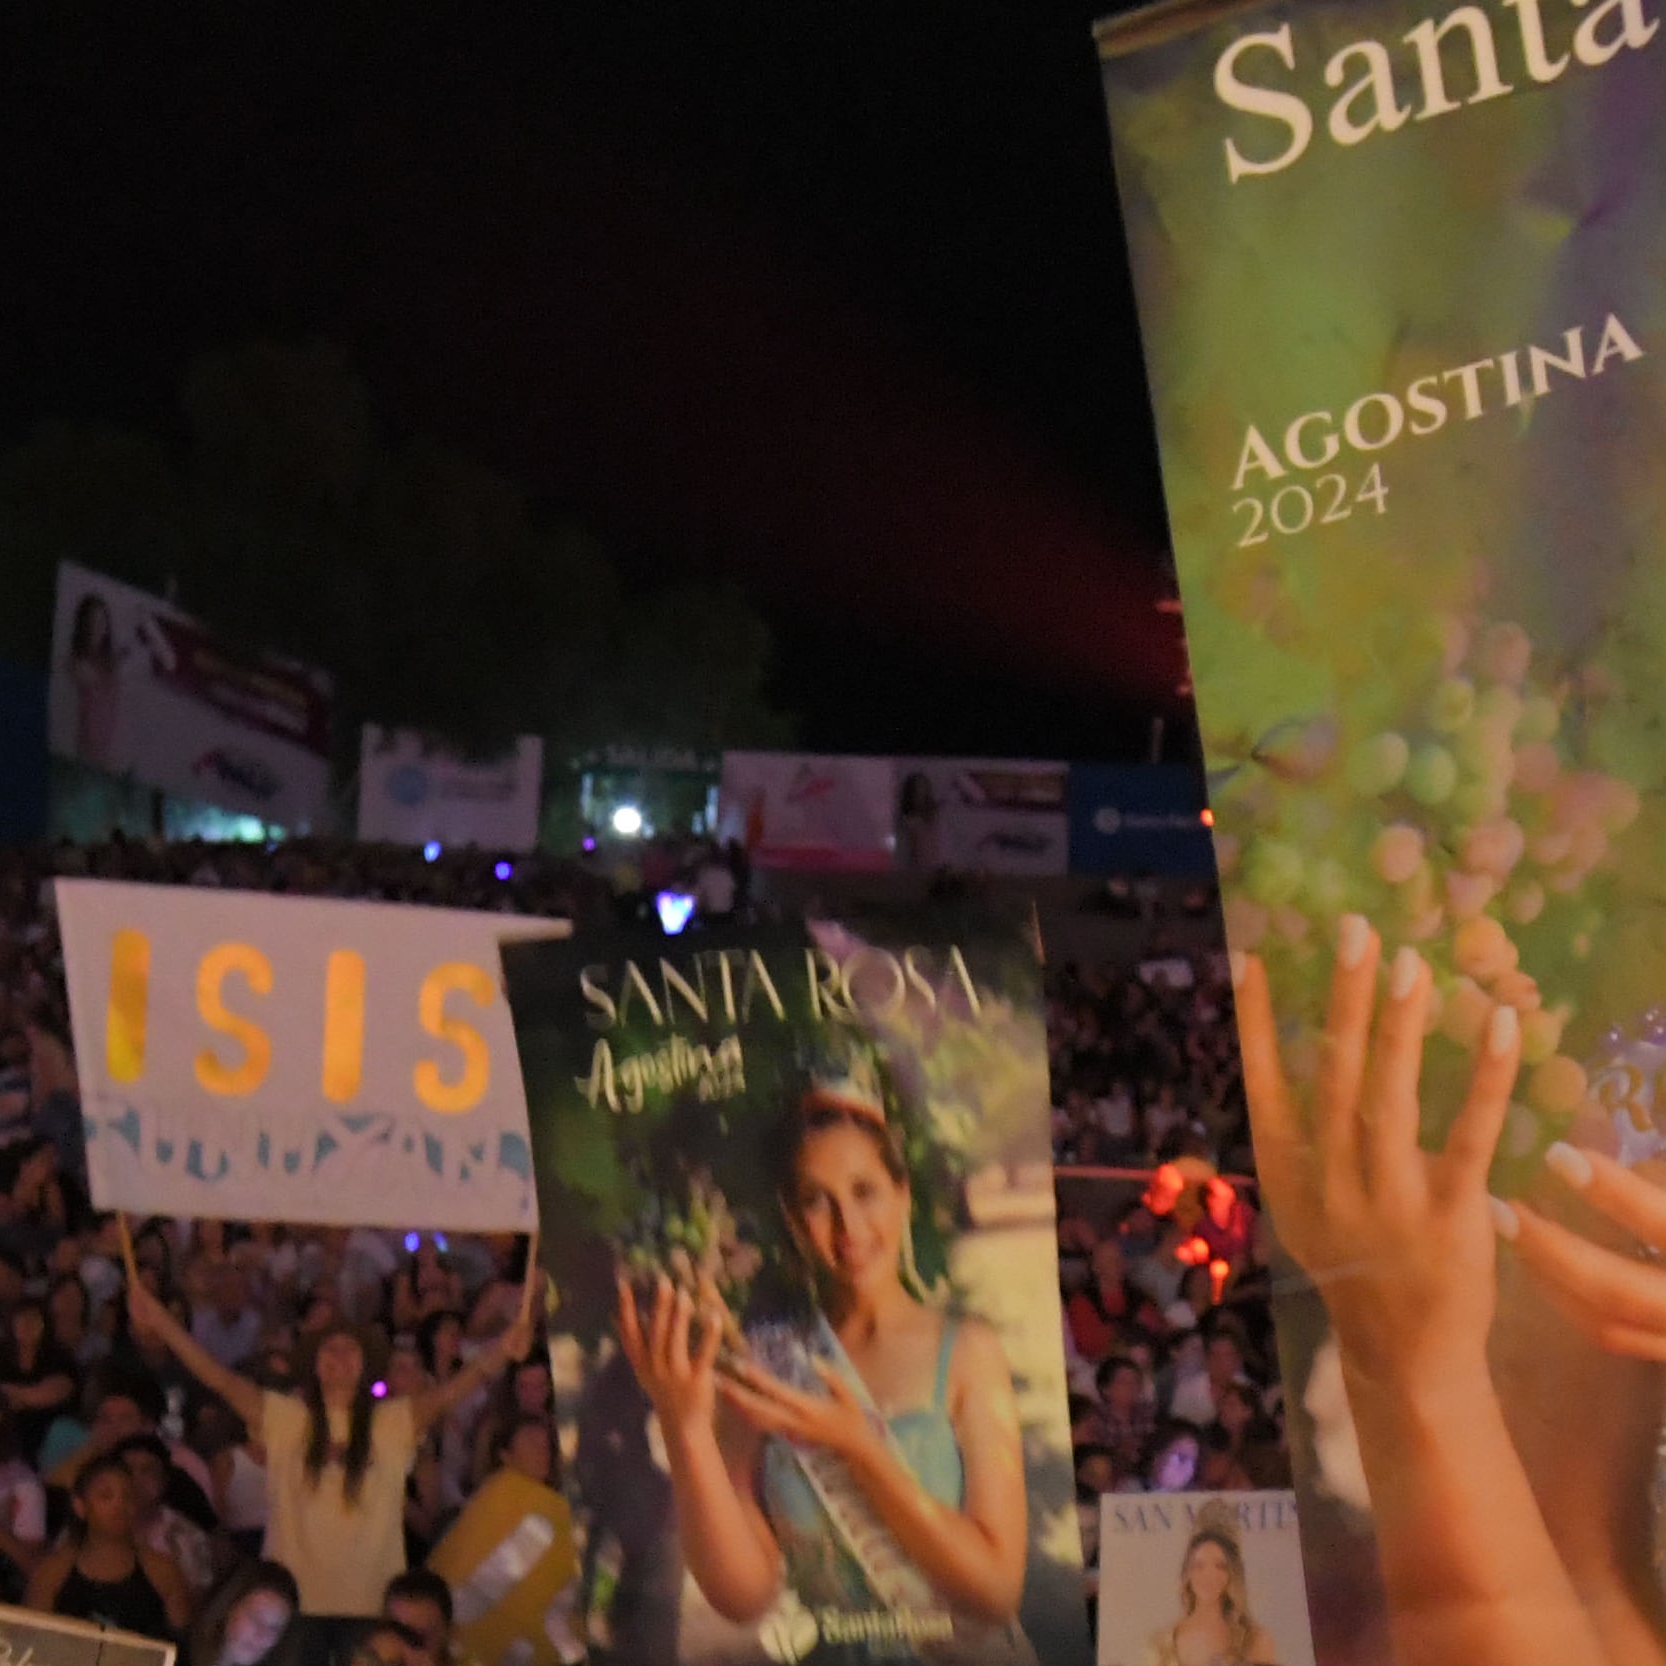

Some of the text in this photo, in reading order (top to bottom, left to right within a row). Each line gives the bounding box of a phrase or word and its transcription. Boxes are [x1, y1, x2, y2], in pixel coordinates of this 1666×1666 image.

[1212, 0, 1661, 184] Santa
[1230, 311, 1647, 491] AGOSTINA
[1230, 462, 1392, 548] 2024
[105, 929, 496, 1114] ISIS
[579, 943, 983, 1028] SANTA ROSA
